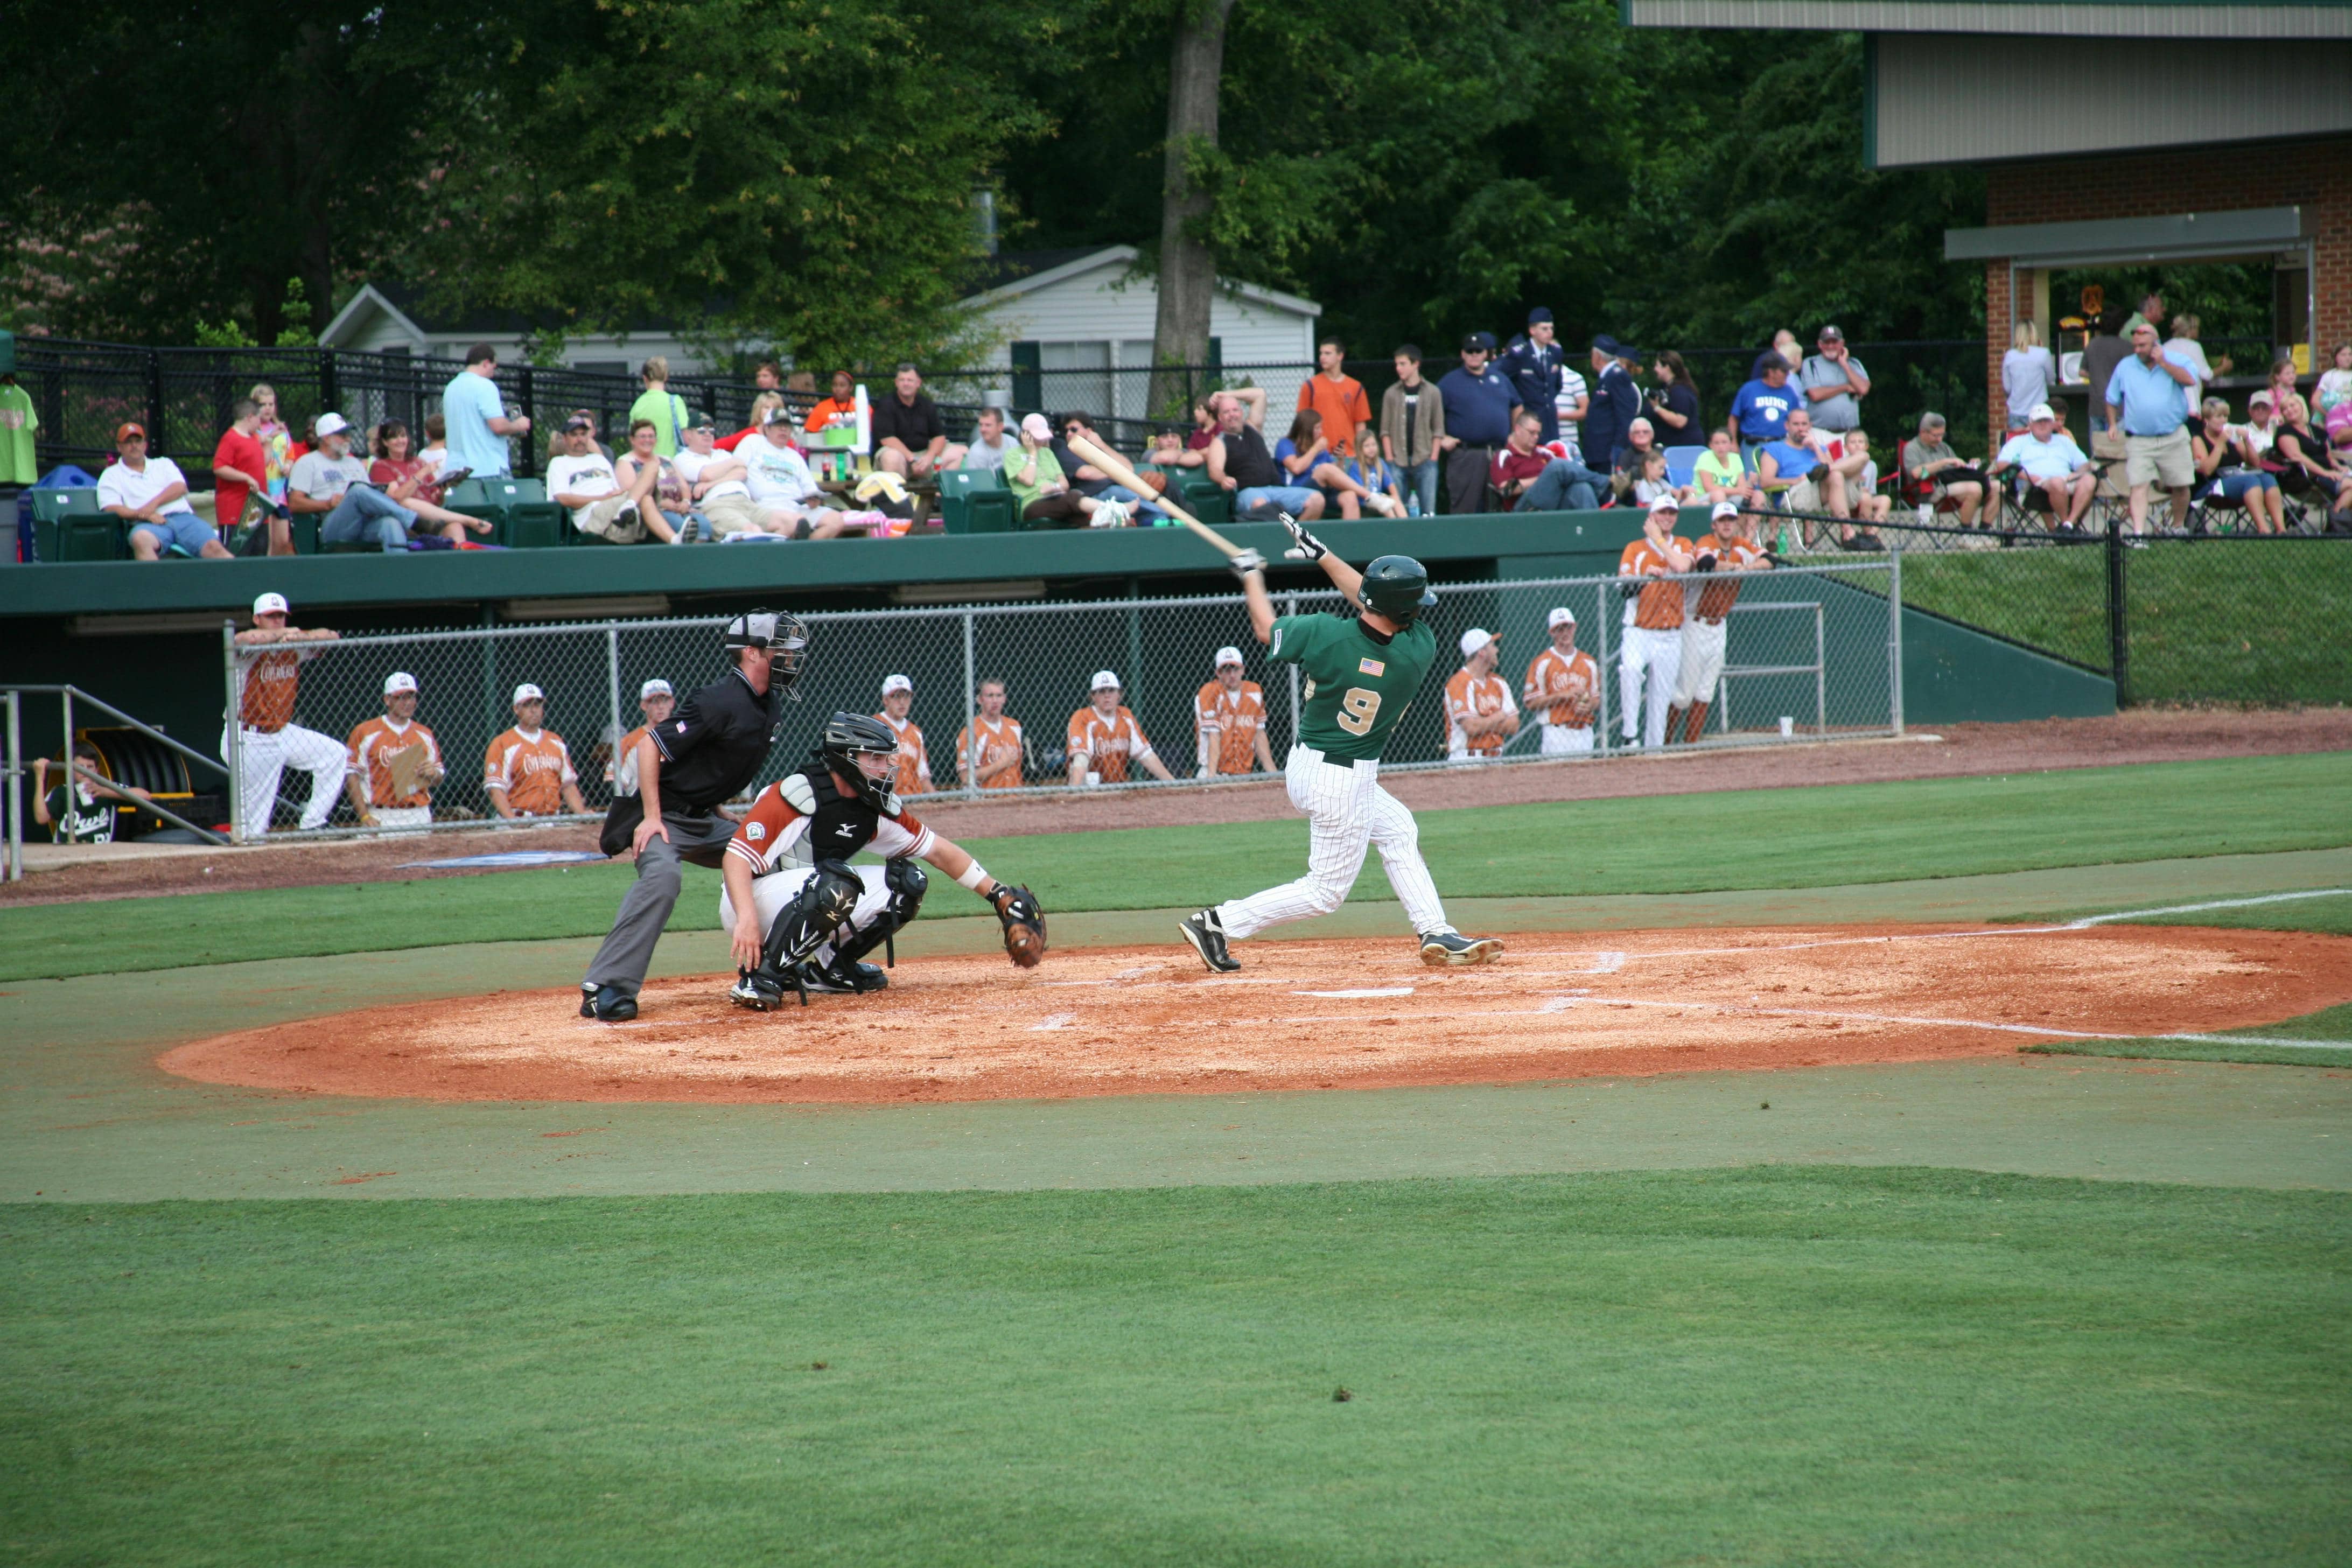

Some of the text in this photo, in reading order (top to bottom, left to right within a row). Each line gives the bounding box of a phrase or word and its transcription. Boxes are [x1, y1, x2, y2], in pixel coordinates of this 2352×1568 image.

[1755, 396, 1788, 411] DUKE
[1336, 687, 1382, 736] 9
[59, 807, 110, 835] Owls
